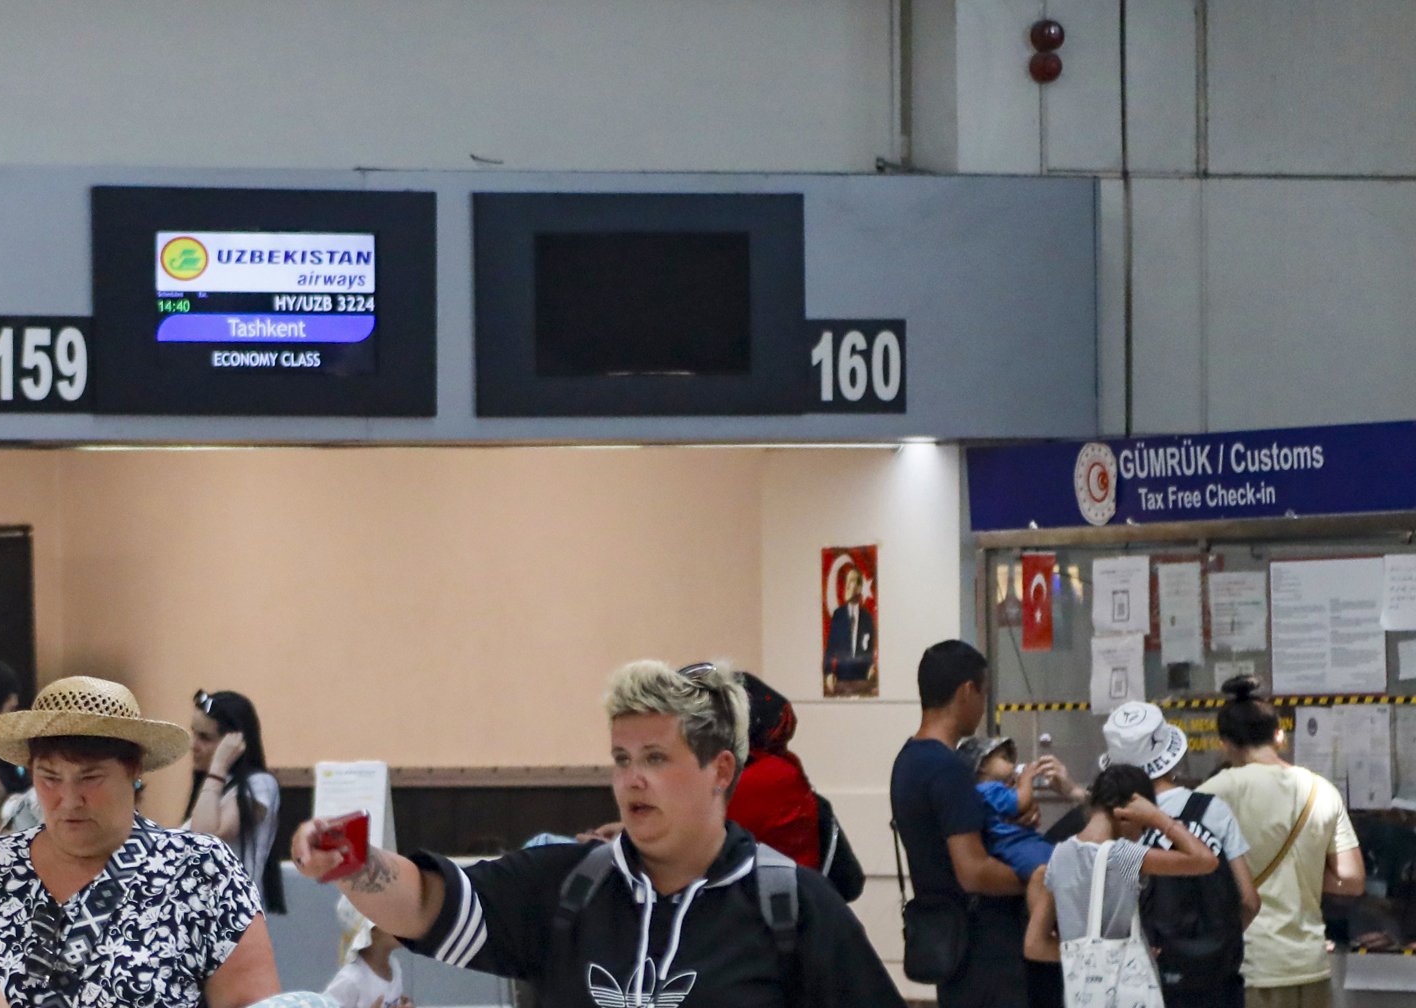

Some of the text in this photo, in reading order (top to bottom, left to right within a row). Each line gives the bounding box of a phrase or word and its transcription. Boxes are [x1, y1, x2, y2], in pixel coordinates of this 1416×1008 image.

[217, 249, 372, 266] UZBEKISTAN
[297, 270, 366, 289] airways
[158, 300, 190, 313] 14:40
[273, 296, 374, 312] HY/UZB 3224
[227, 317, 306, 338] Tashkent
[213, 350, 321, 367] ECONOMY CLASS
[811, 330, 901, 402] 160
[1119, 442, 1325, 480] GÜMRÜK / Customs
[1138, 481, 1276, 511] Tax Free Check-in
